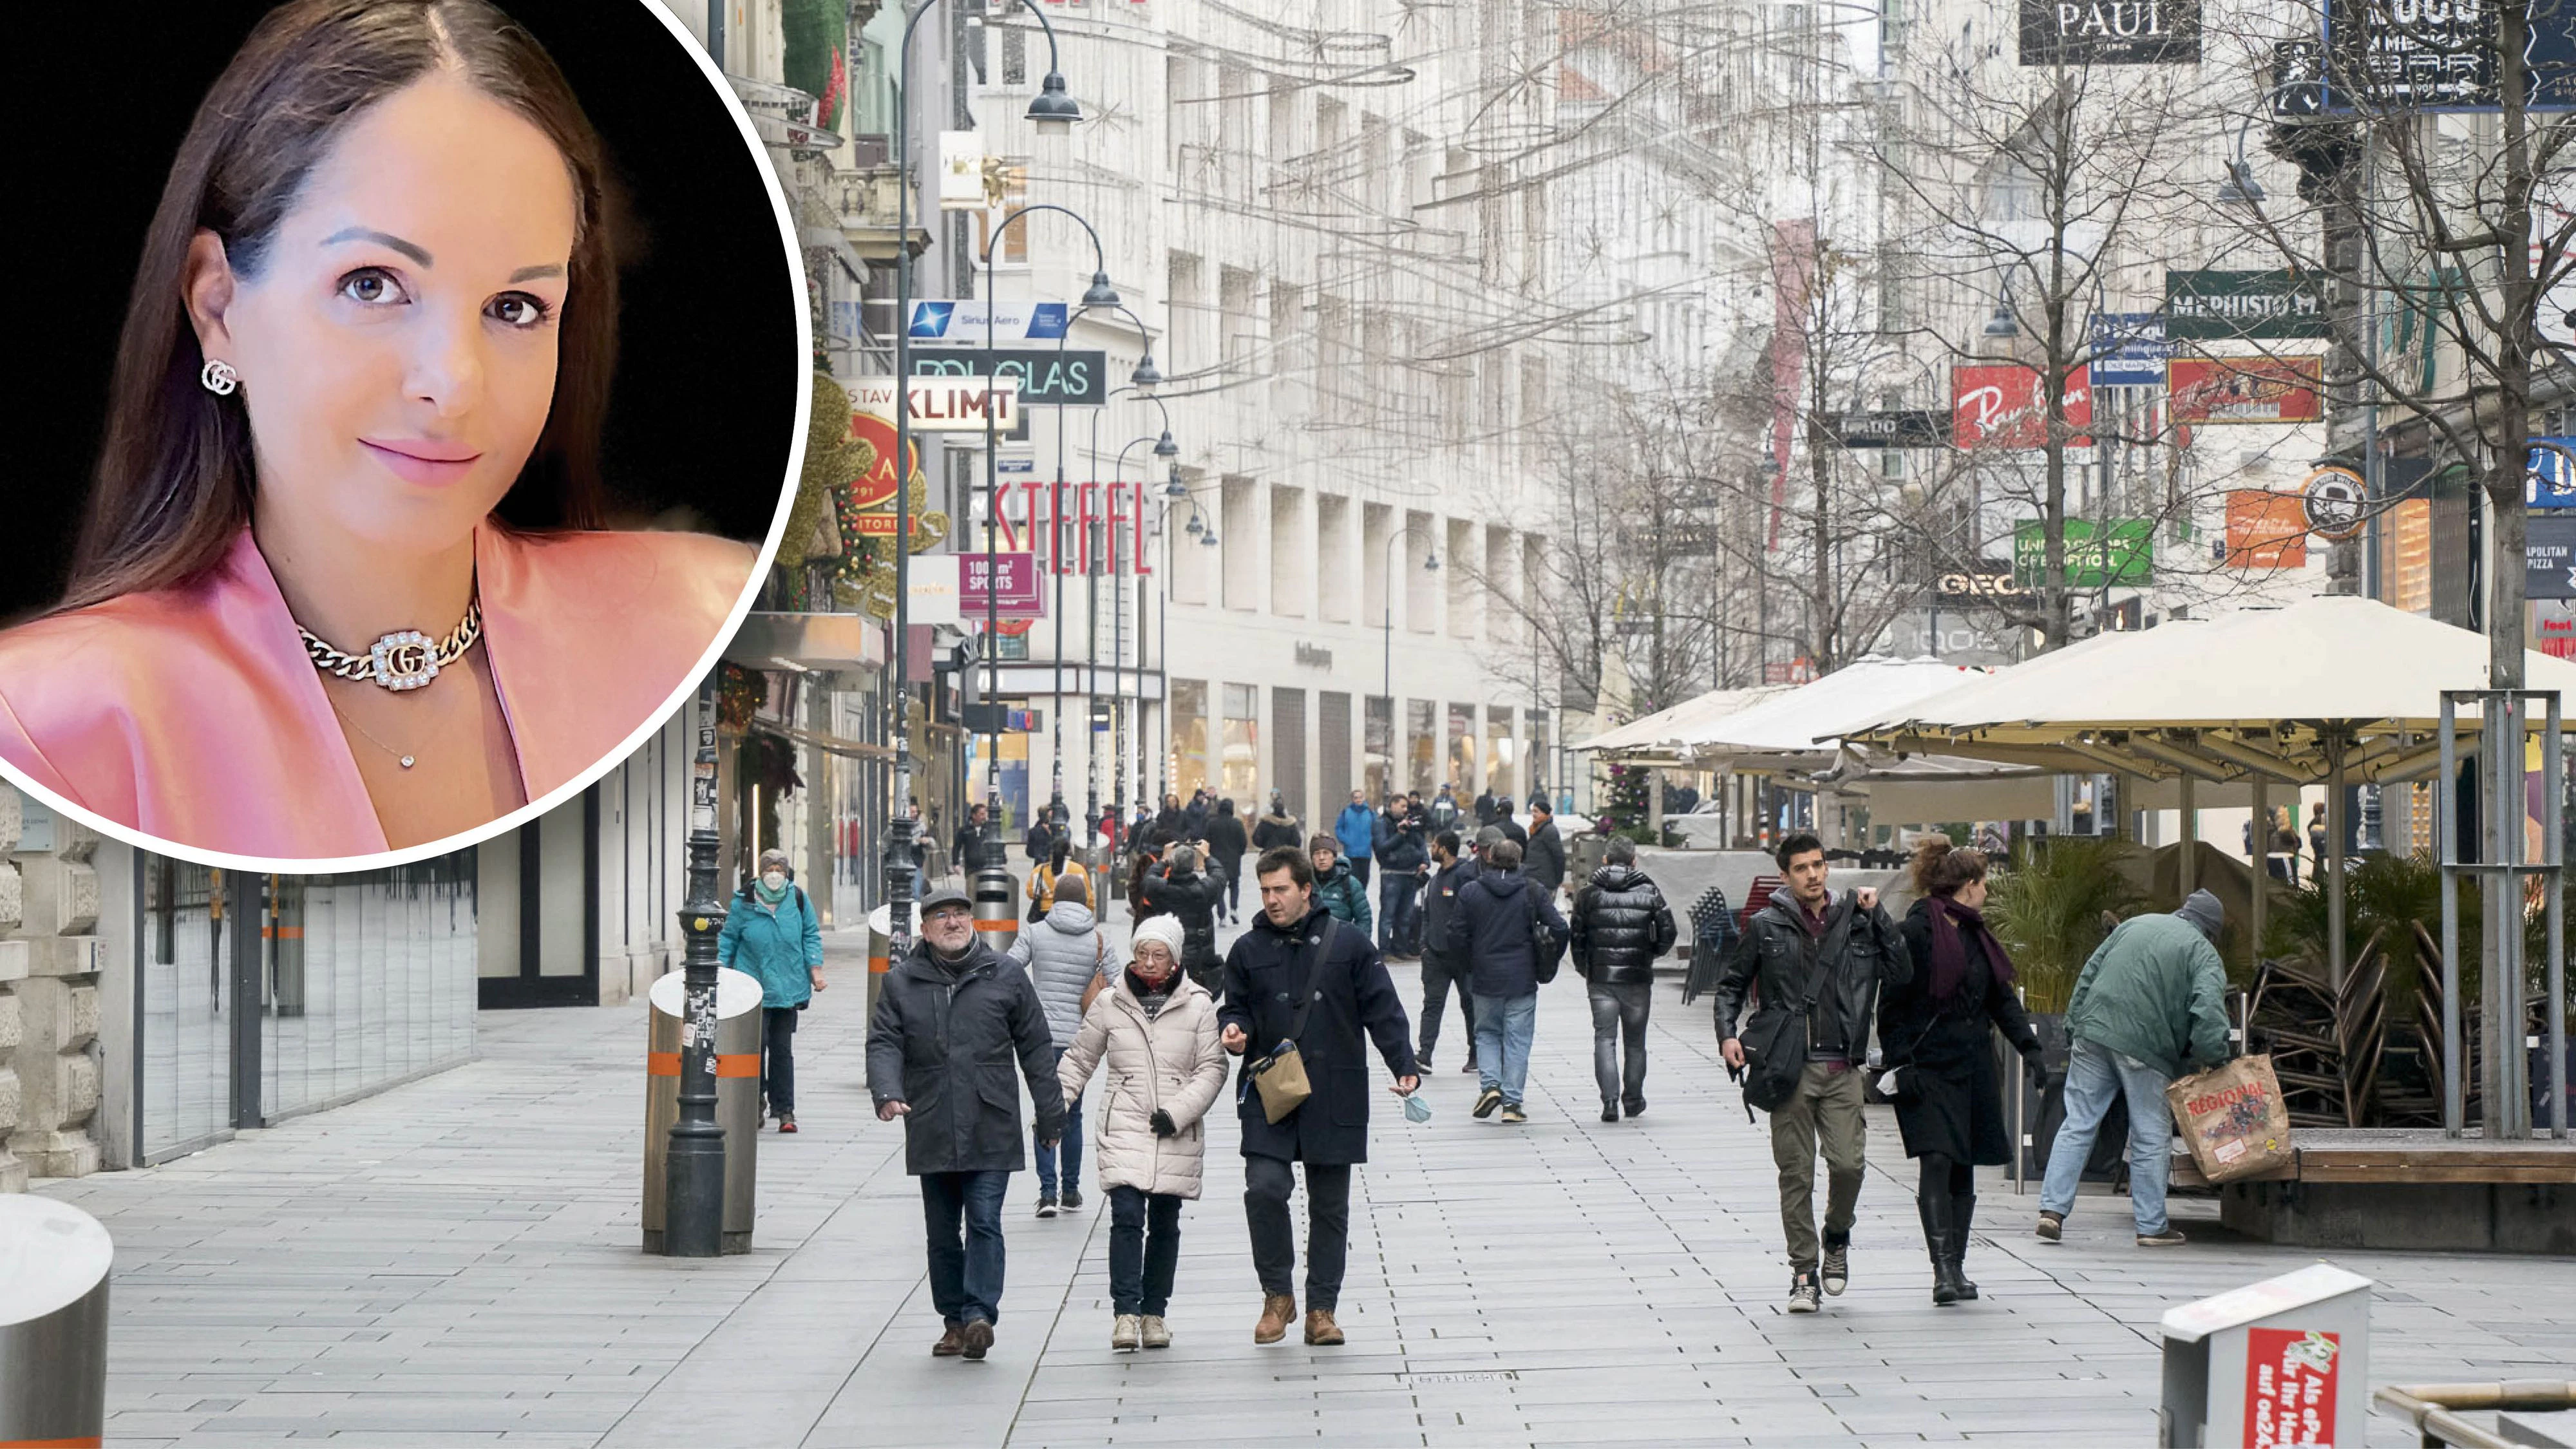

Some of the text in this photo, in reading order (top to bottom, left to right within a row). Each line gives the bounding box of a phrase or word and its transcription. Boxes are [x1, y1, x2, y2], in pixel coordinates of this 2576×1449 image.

[2057, 3, 2172, 35] PAUL
[2173, 295, 2289, 316] MEPHISTO
[915, 359, 1088, 395] DOGLAS
[848, 388, 893, 404] STAV
[907, 388, 1014, 419] KLIMT
[994, 481, 1151, 574] STEFFL
[969, 561, 992, 574] 100
[2527, 558, 2553, 569] PIZZA
[969, 576, 1014, 590] SPOTS
[1938, 574, 2031, 595] GEO
[2186, 1082, 2267, 1117] REGIONAL
[2258, 1363, 2277, 1397] auf
[2280, 1382, 2300, 1409] Ihr
[2302, 1374, 2324, 1444] Als ePa
[2278, 1411, 2298, 1444] Han
